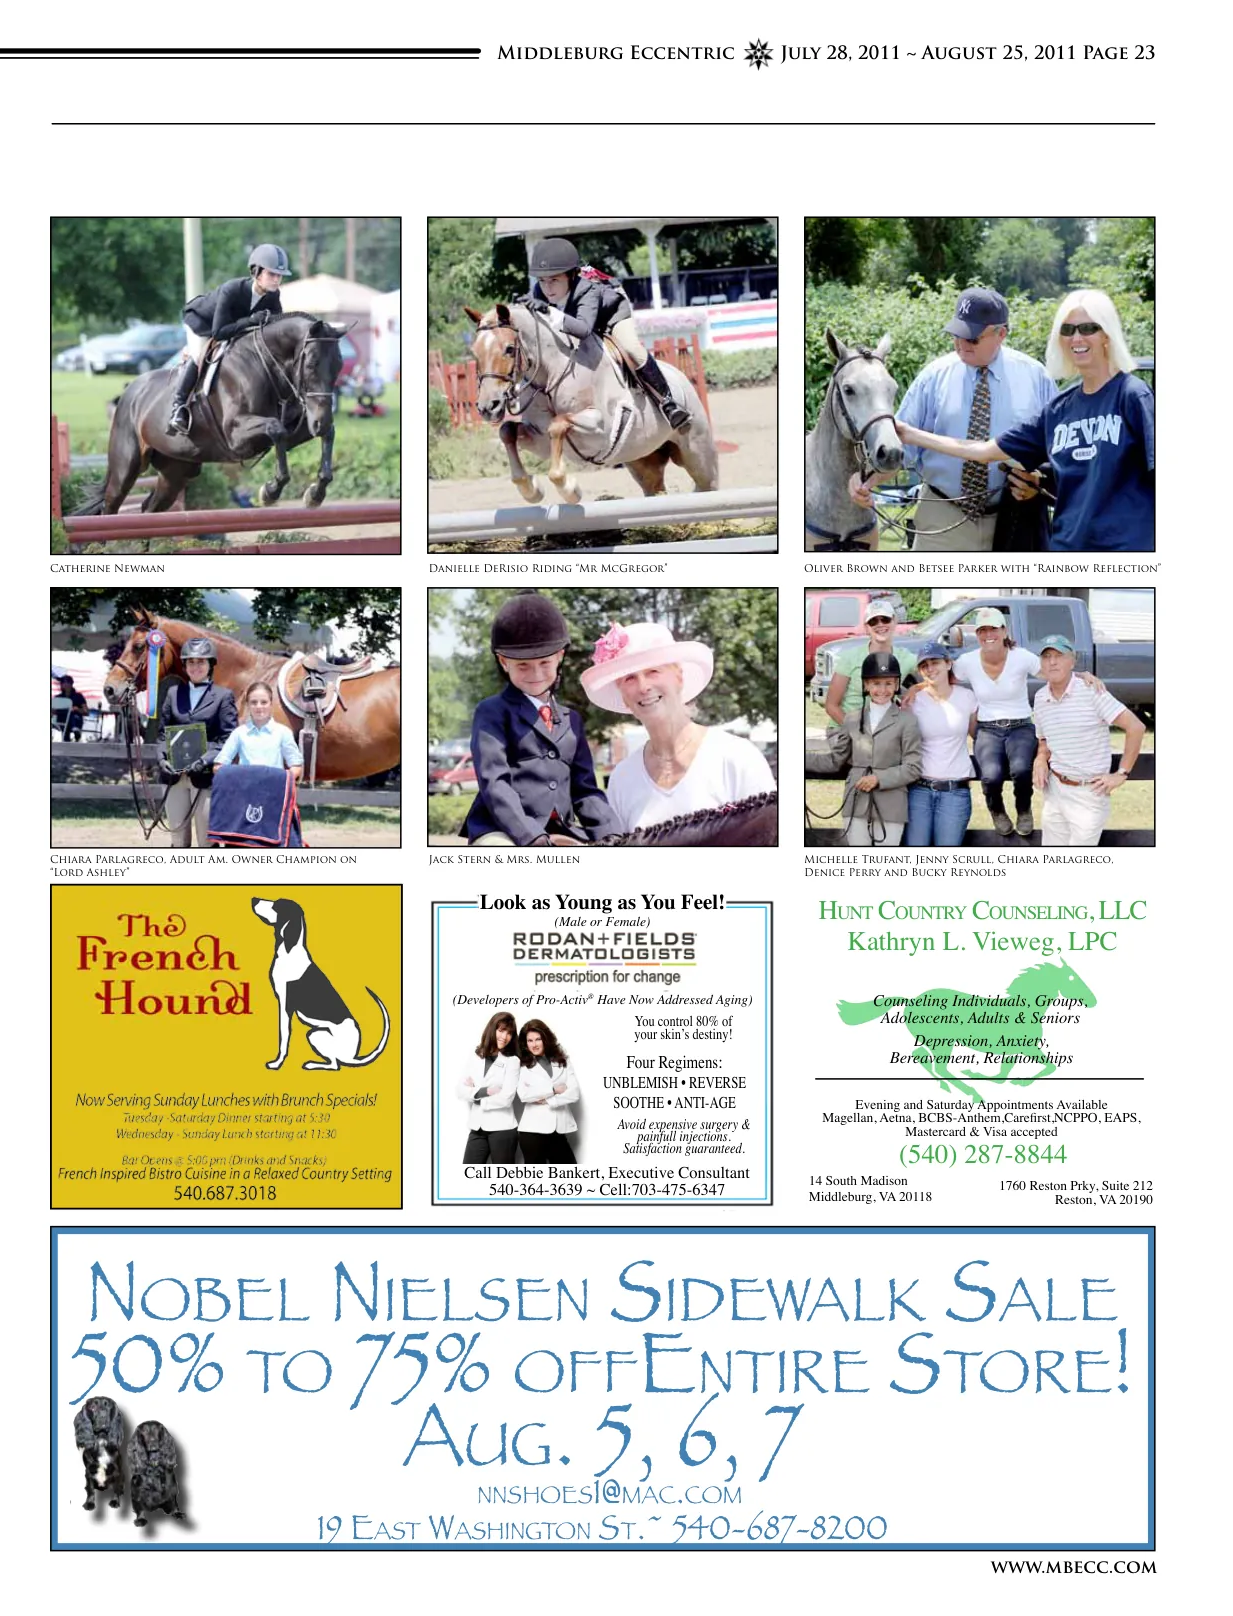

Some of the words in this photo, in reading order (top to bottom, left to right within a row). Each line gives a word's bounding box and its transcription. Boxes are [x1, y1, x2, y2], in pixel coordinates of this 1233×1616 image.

[498, 45, 623, 59] MIDDLEBURG
[631, 45, 734, 59] ECCENTRIC
[781, 45, 821, 64] JULY
[827, 45, 851, 61] 28,
[859, 45, 899, 59] 2011
[921, 45, 997, 59] AUGUST
[1003, 45, 1027, 61] 25,
[1035, 45, 1074, 59] 2011
[1084, 45, 1128, 59] PAGE
[1135, 45, 1155, 60] 23
[49, 563, 111, 573] CATHERINE
[114, 563, 165, 573] NEWMAN
[804, 563, 844, 573] OLIVER
[847, 563, 888, 573] BROWN
[890, 564, 915, 573] AND
[919, 563, 955, 573] BETSEE
[958, 563, 998, 573] PARKER
[1000, 564, 1030, 573] WITH
[430, 855, 454, 865] JACK
[457, 854, 491, 864] STERN
[494, 854, 504, 864] &
[506, 854, 533, 864] MRS.
[536, 854, 580, 864] MULLEN
[480, 894, 526, 910] Look
[532, 899, 550, 909] as
[556, 894, 612, 914] Young
[618, 899, 636, 909] as
[641, 894, 675, 910] You
[681, 894, 724, 910] Feel!
[819, 901, 873, 919] HUNT
[879, 901, 966, 920] COUNTRY
[973, 901, 1094, 922] COUNSELING,
[1099, 901, 1146, 920] LLC
[118, 914, 186, 936] The
[77, 933, 239, 970] French
[514, 949, 694, 959] DERMATOLOGISTS
[95, 980, 252, 1015] Hound
[900, 1145, 956, 1167] (540)
[965, 1145, 1067, 1163] 287-8844
[464, 1166, 492, 1179] Call
[496, 1166, 544, 1179] Debbie
[548, 1166, 605, 1181] Bankert,
[608, 1166, 675, 1179] Executive
[678, 1166, 750, 1179] Consultant
[175, 1186, 276, 1200] 540.687.3018
[91, 1261, 309, 1322] NOBEL
[335, 1261, 587, 1321] NIELSEN
[611, 1260, 926, 1322] SIDEWALK
[946, 1260, 1117, 1322] SALE
[69, 1331, 223, 1406] 50%
[246, 1350, 332, 1393] TO
[350, 1332, 489, 1410] 75%
[890, 1330, 1128, 1394] STORE!
[991, 1561, 1157, 1573] WWW.MBECC.COM
